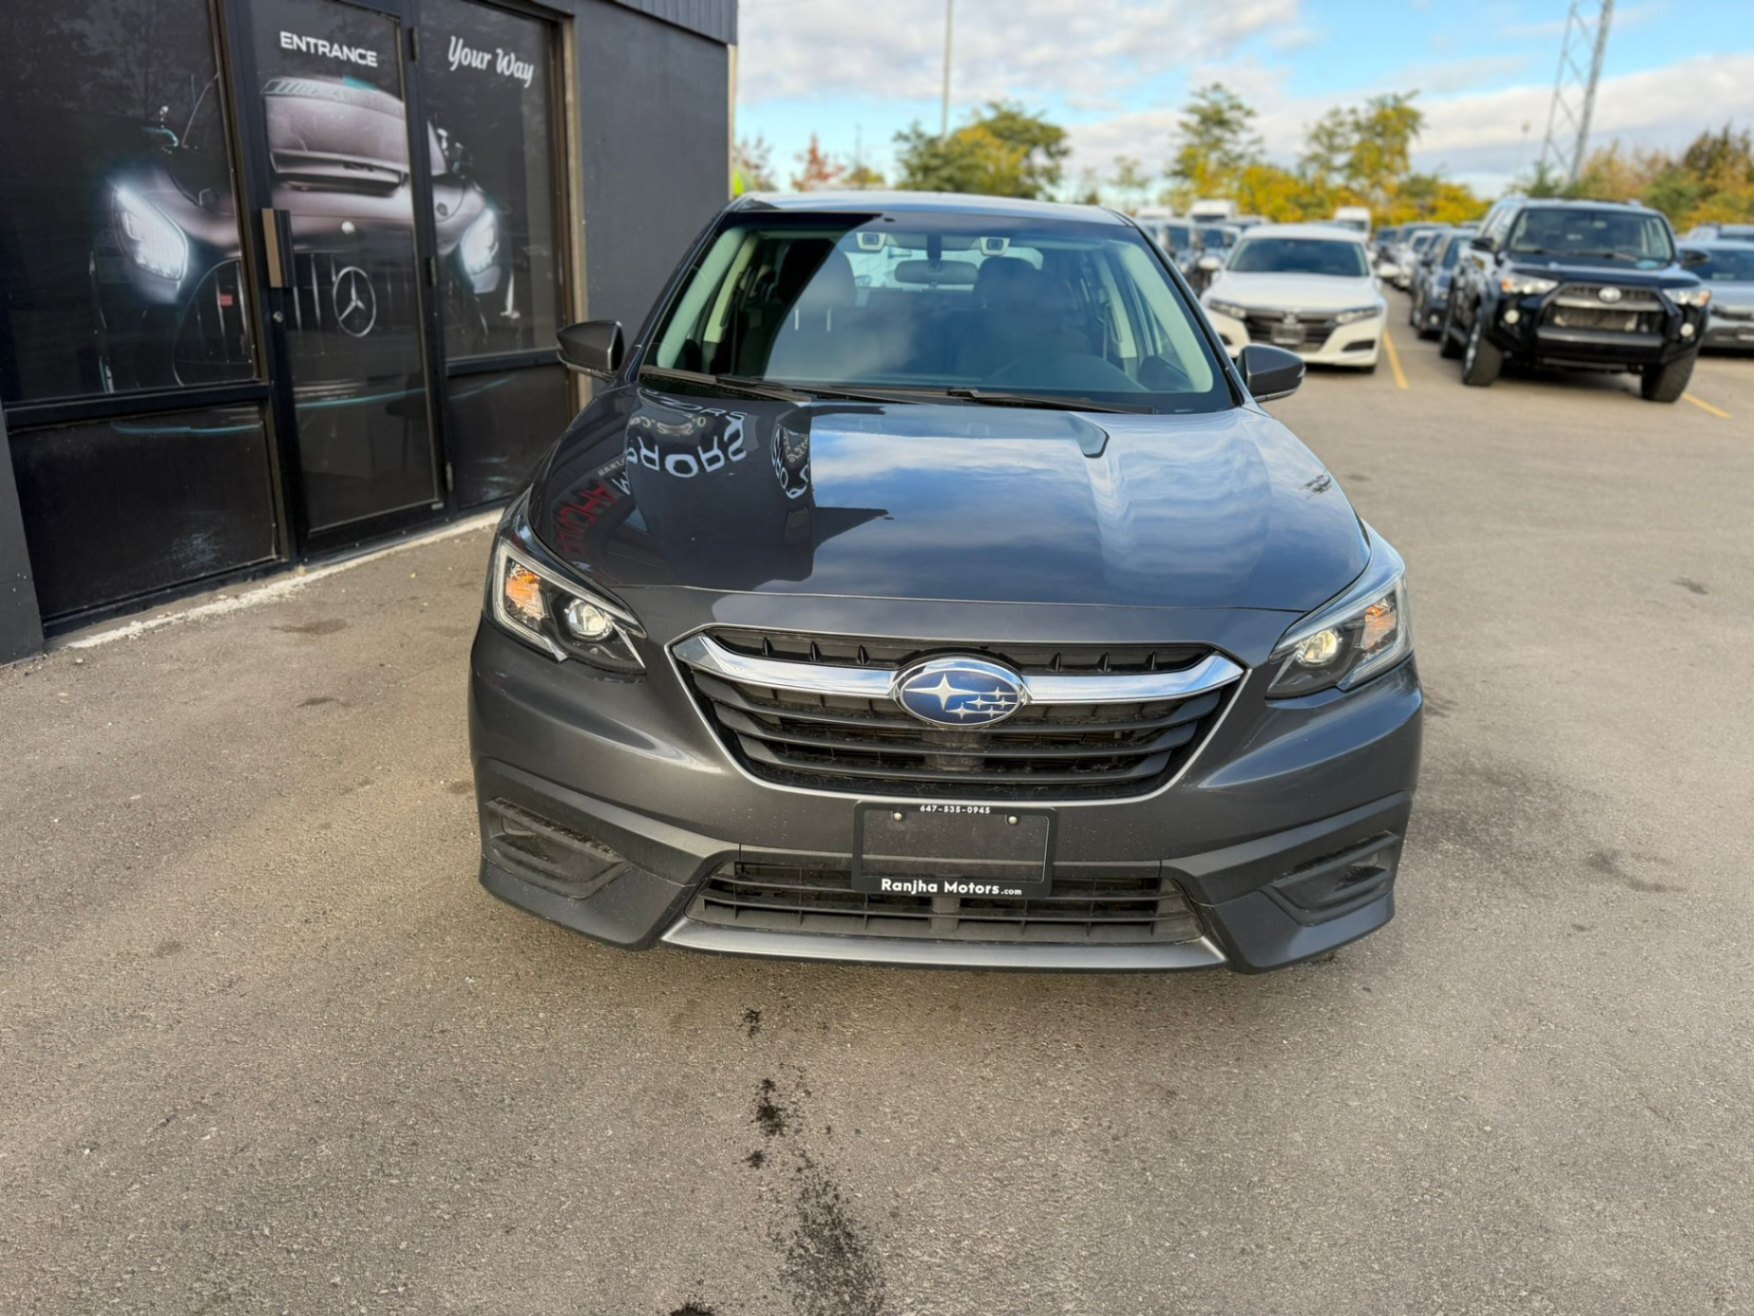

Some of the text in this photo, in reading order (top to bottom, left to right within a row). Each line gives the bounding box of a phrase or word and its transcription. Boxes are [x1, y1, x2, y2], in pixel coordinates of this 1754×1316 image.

[280, 31, 378, 67] ENTRANCE
[448, 35, 534, 88] Your Way
[920, 804, 991, 815] 647-535-0945
[881, 878, 938, 895] Ranjha
